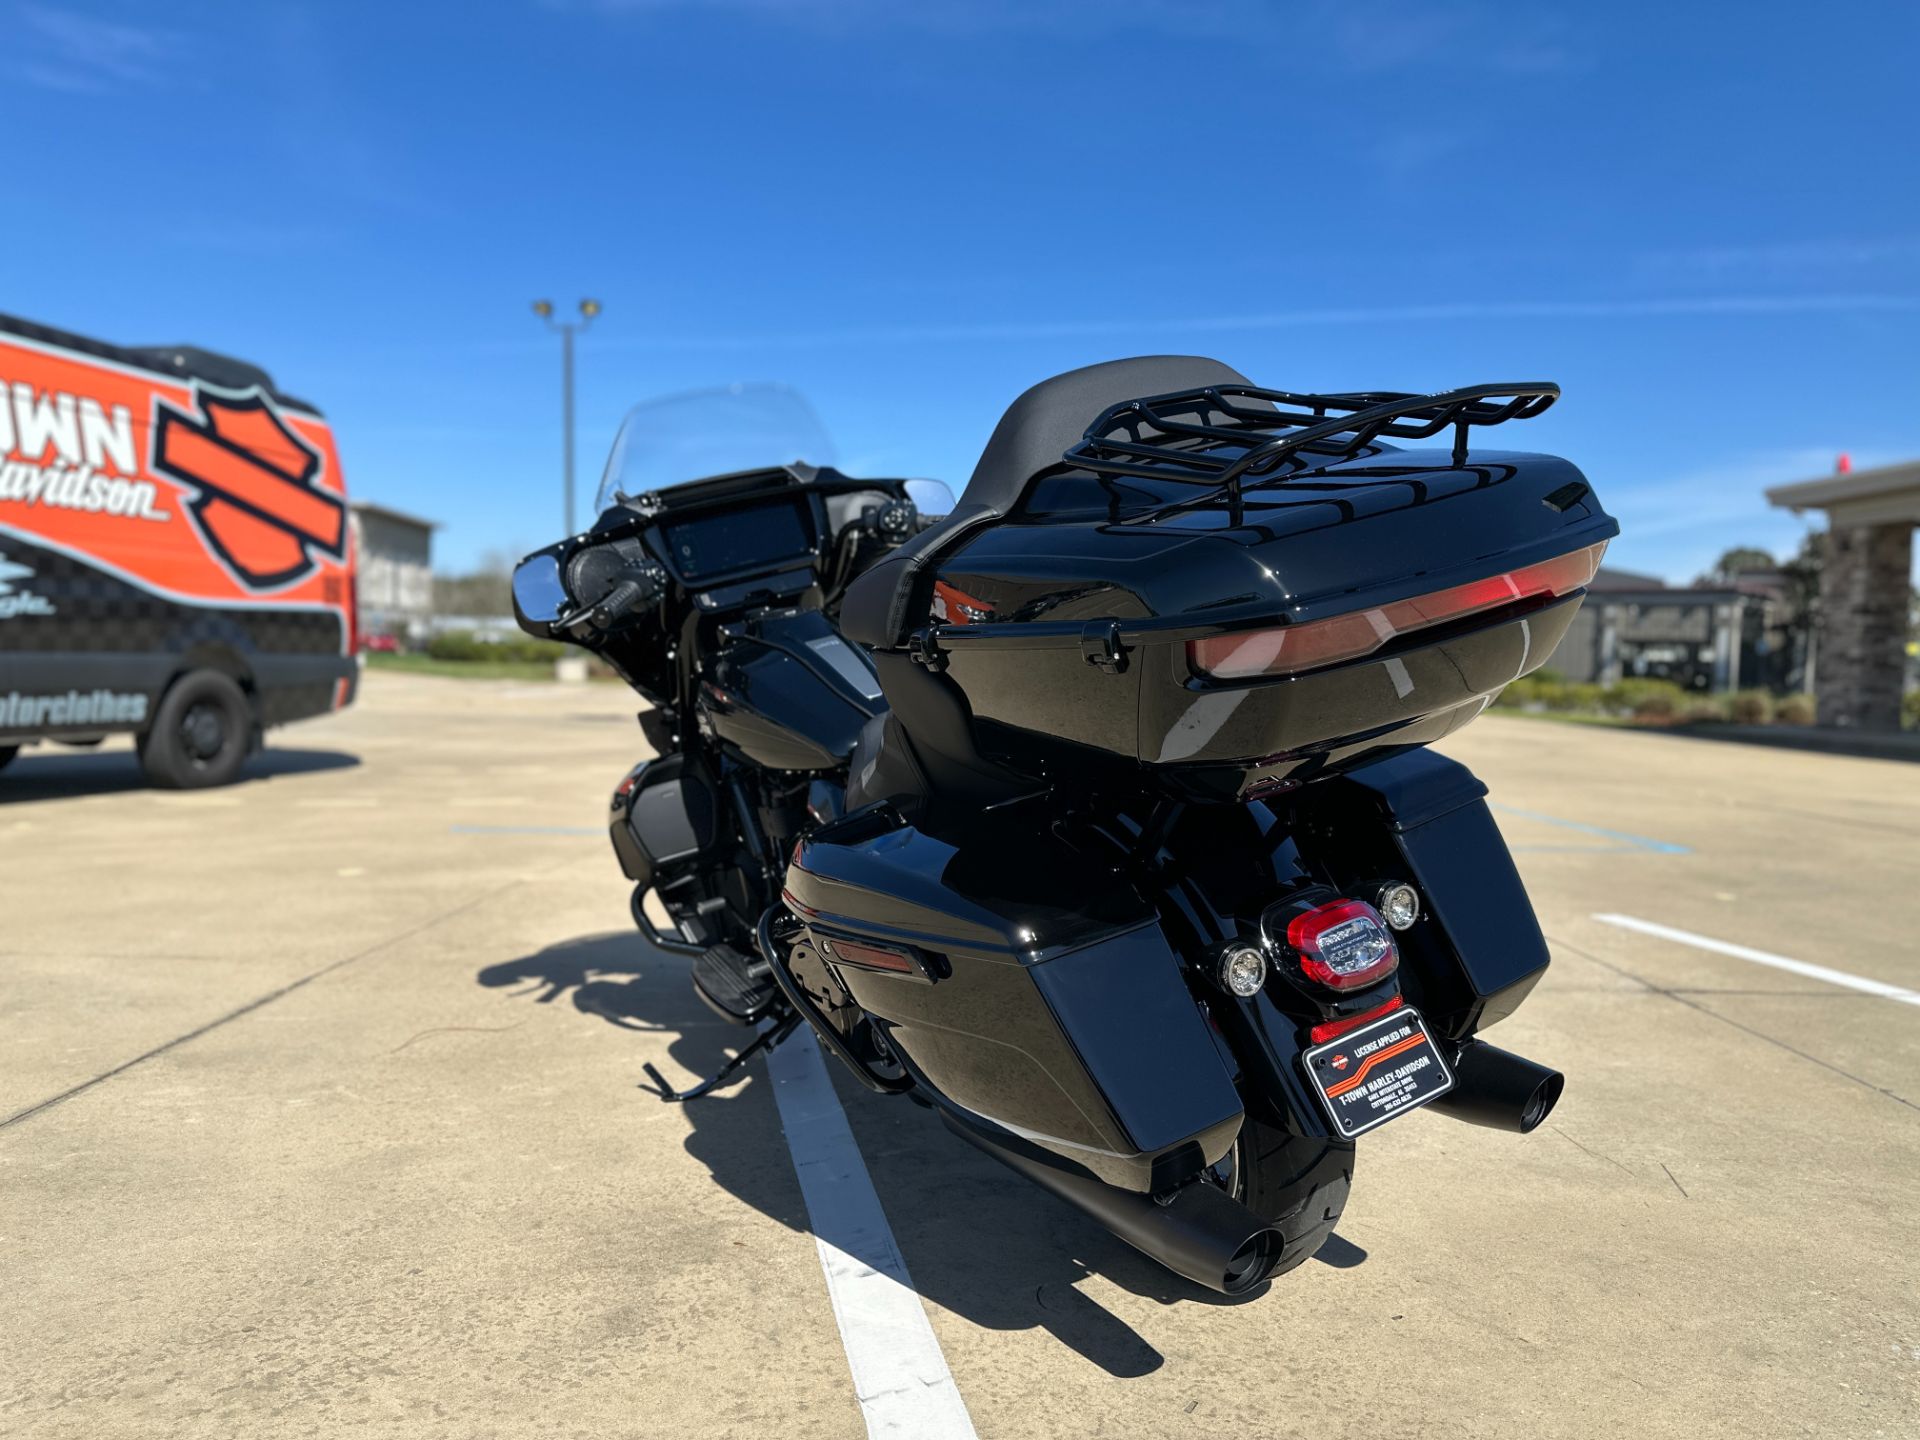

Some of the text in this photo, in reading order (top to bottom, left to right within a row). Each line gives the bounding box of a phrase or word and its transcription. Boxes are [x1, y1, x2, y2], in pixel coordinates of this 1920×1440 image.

[0, 456, 171, 521] avidson
[1353, 1025, 1412, 1058] LICENSE APPLIED FOR
[1338, 1085, 1369, 1106] T-TOWN
[1367, 1055, 1431, 1092] HARLEY-DAVIDSON
